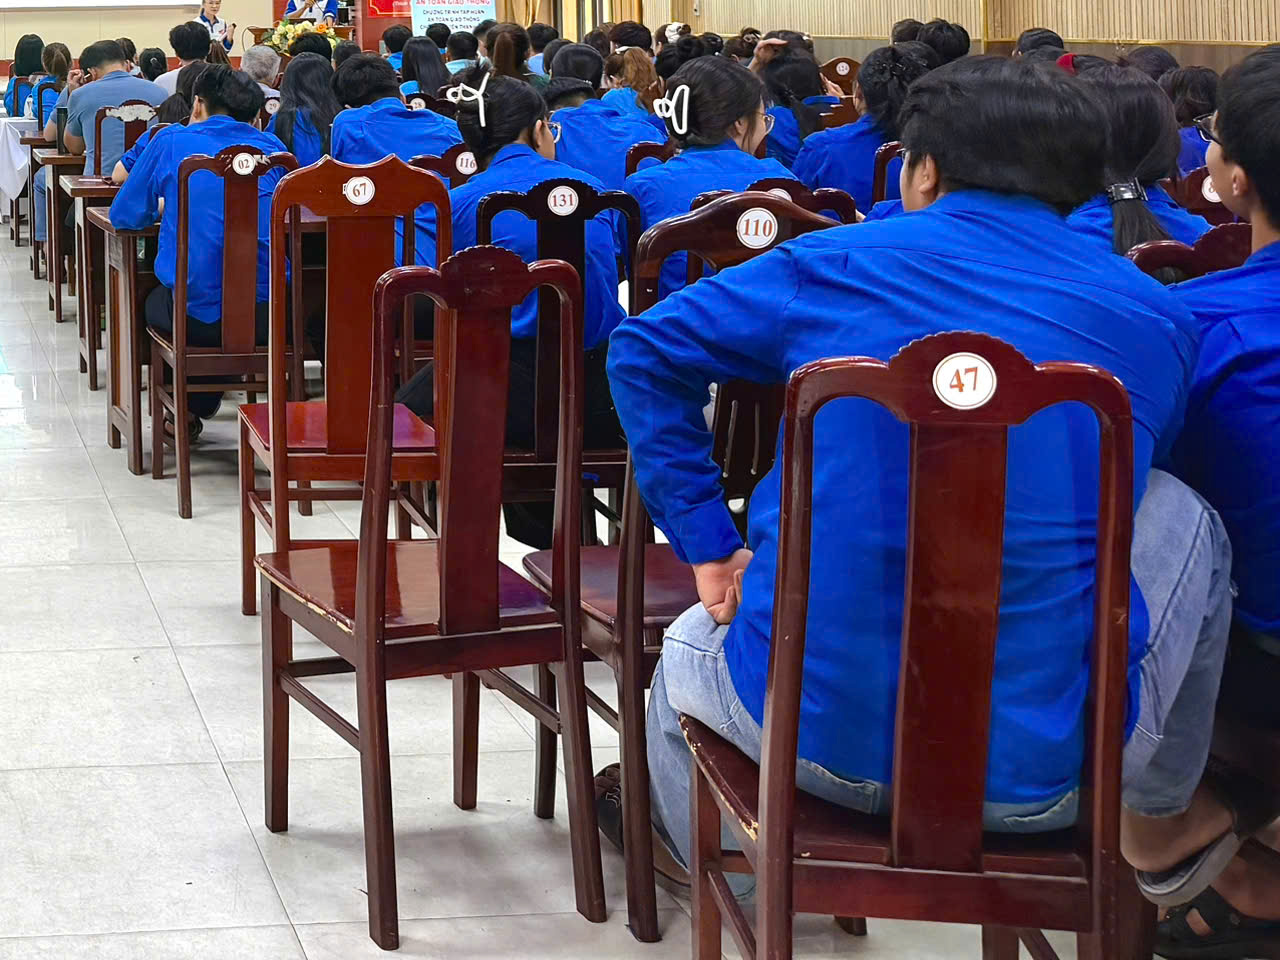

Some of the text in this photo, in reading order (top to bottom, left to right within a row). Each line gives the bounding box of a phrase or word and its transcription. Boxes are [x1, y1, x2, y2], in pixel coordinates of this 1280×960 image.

[238, 159, 250, 170] 02
[460, 158, 475, 169] 116
[353, 182, 368, 197] 67
[552, 194, 575, 208] 131
[744, 218, 773, 237] 110
[949, 366, 979, 393] 47
